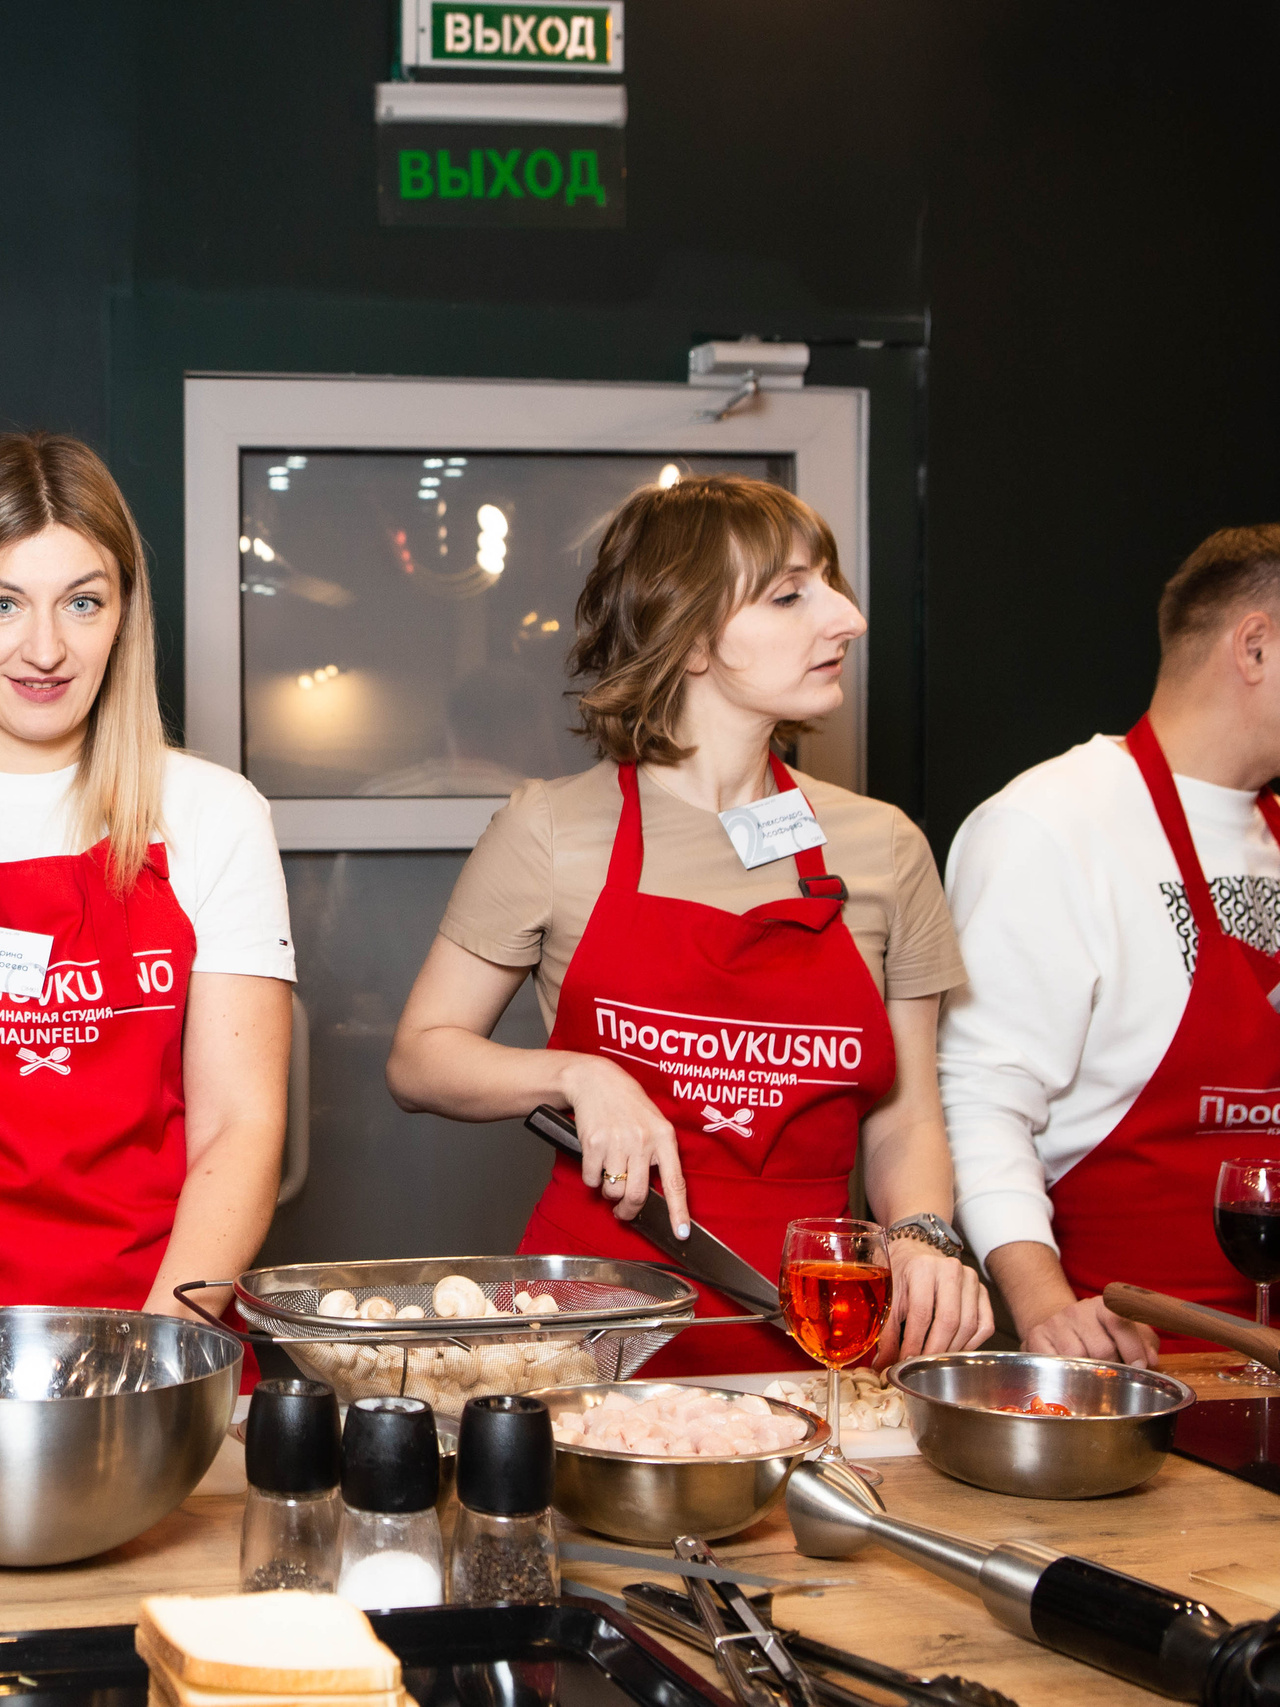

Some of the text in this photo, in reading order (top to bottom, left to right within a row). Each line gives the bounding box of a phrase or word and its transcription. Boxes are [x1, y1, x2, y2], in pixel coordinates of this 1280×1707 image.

[444, 12, 596, 60] ВЫХОД
[398, 149, 606, 207] ВЫХОД
[721, 806, 779, 869] 2
[62, 1006, 114, 1023] СТУДИЯ
[595, 1007, 862, 1070] ПростоVKUSNO
[659, 1059, 798, 1087] КУЛИНАРНАЯ СТУДИЯ
[673, 1079, 784, 1108] MAUNFELD
